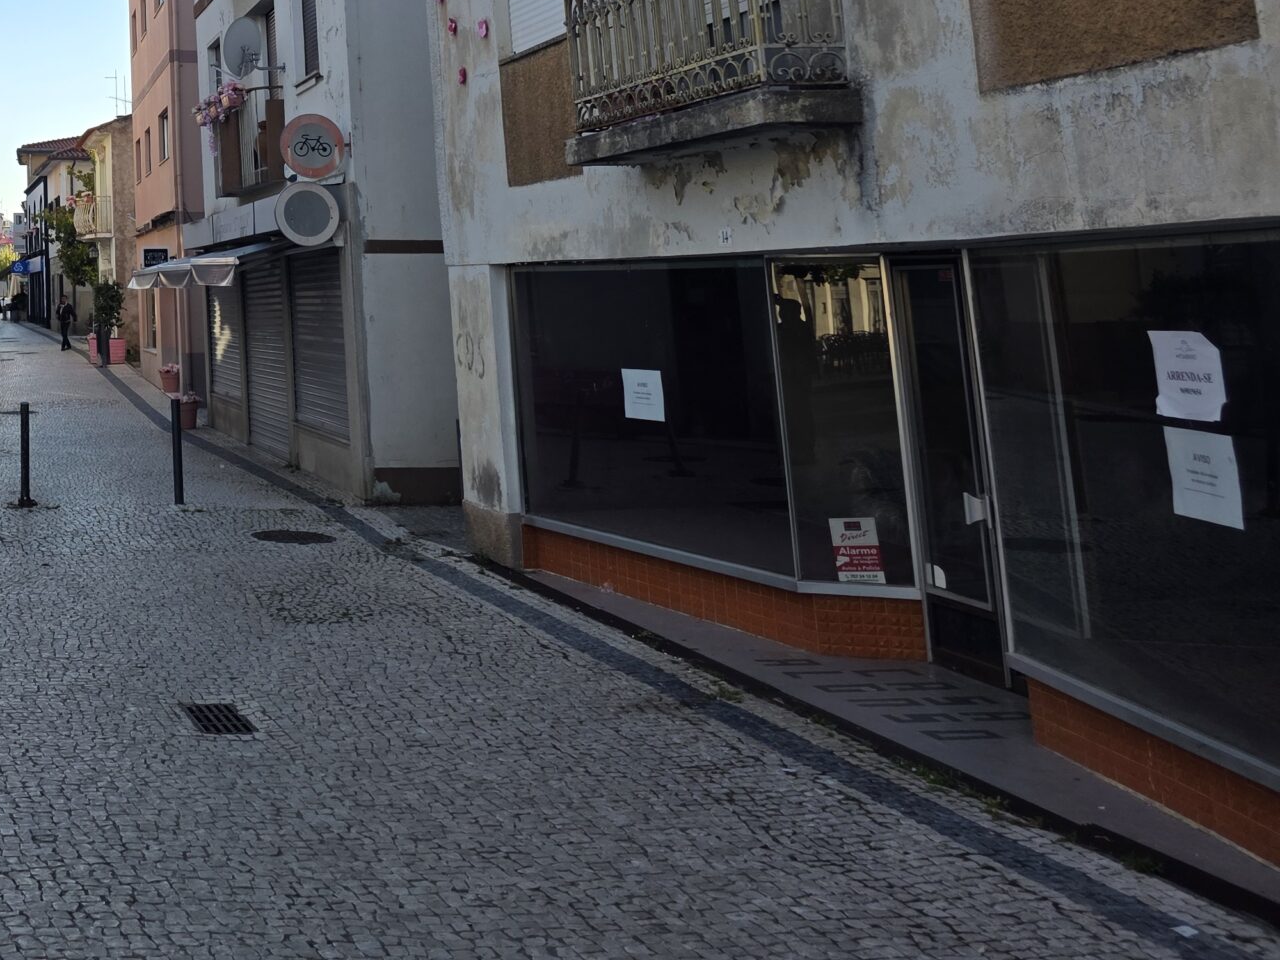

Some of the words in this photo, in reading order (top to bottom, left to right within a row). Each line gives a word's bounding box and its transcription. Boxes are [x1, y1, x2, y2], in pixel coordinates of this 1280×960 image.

[1166, 370, 1214, 384] ARRENDA-SE
[1193, 453, 1211, 465] AVISO
[839, 546, 878, 555] Alarme
